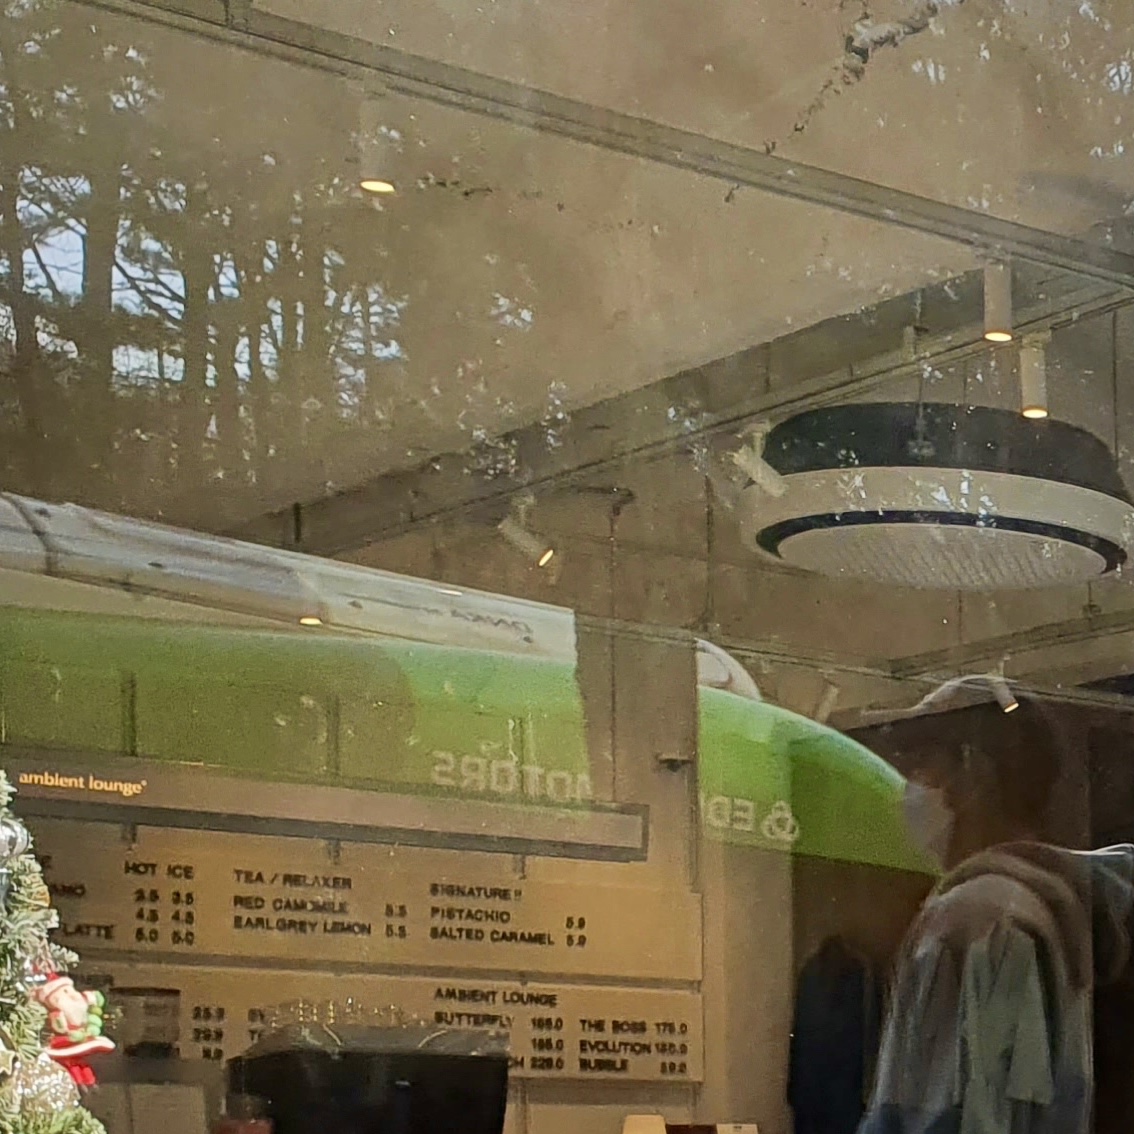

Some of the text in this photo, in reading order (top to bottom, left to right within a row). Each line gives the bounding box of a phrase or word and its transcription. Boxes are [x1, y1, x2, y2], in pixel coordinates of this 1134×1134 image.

[19, 772, 85, 789] ambient
[124, 861, 194, 880] HOT ICE
[234, 869, 264, 884] TEA
[283, 873, 352, 889] RELAXER
[430, 883, 511, 900] SIGNATURE
[234, 895, 265, 910] RED
[430, 906, 511, 924] PISTACHIO
[323, 920, 372, 936] LEMON
[430, 926, 484, 942] SALTED
[490, 929, 555, 946] CARAMEL
[434, 988, 558, 1008] AMBIENT LOUNGE
[579, 1019, 605, 1033] THE
[579, 1040, 652, 1055] EVOLUTION
